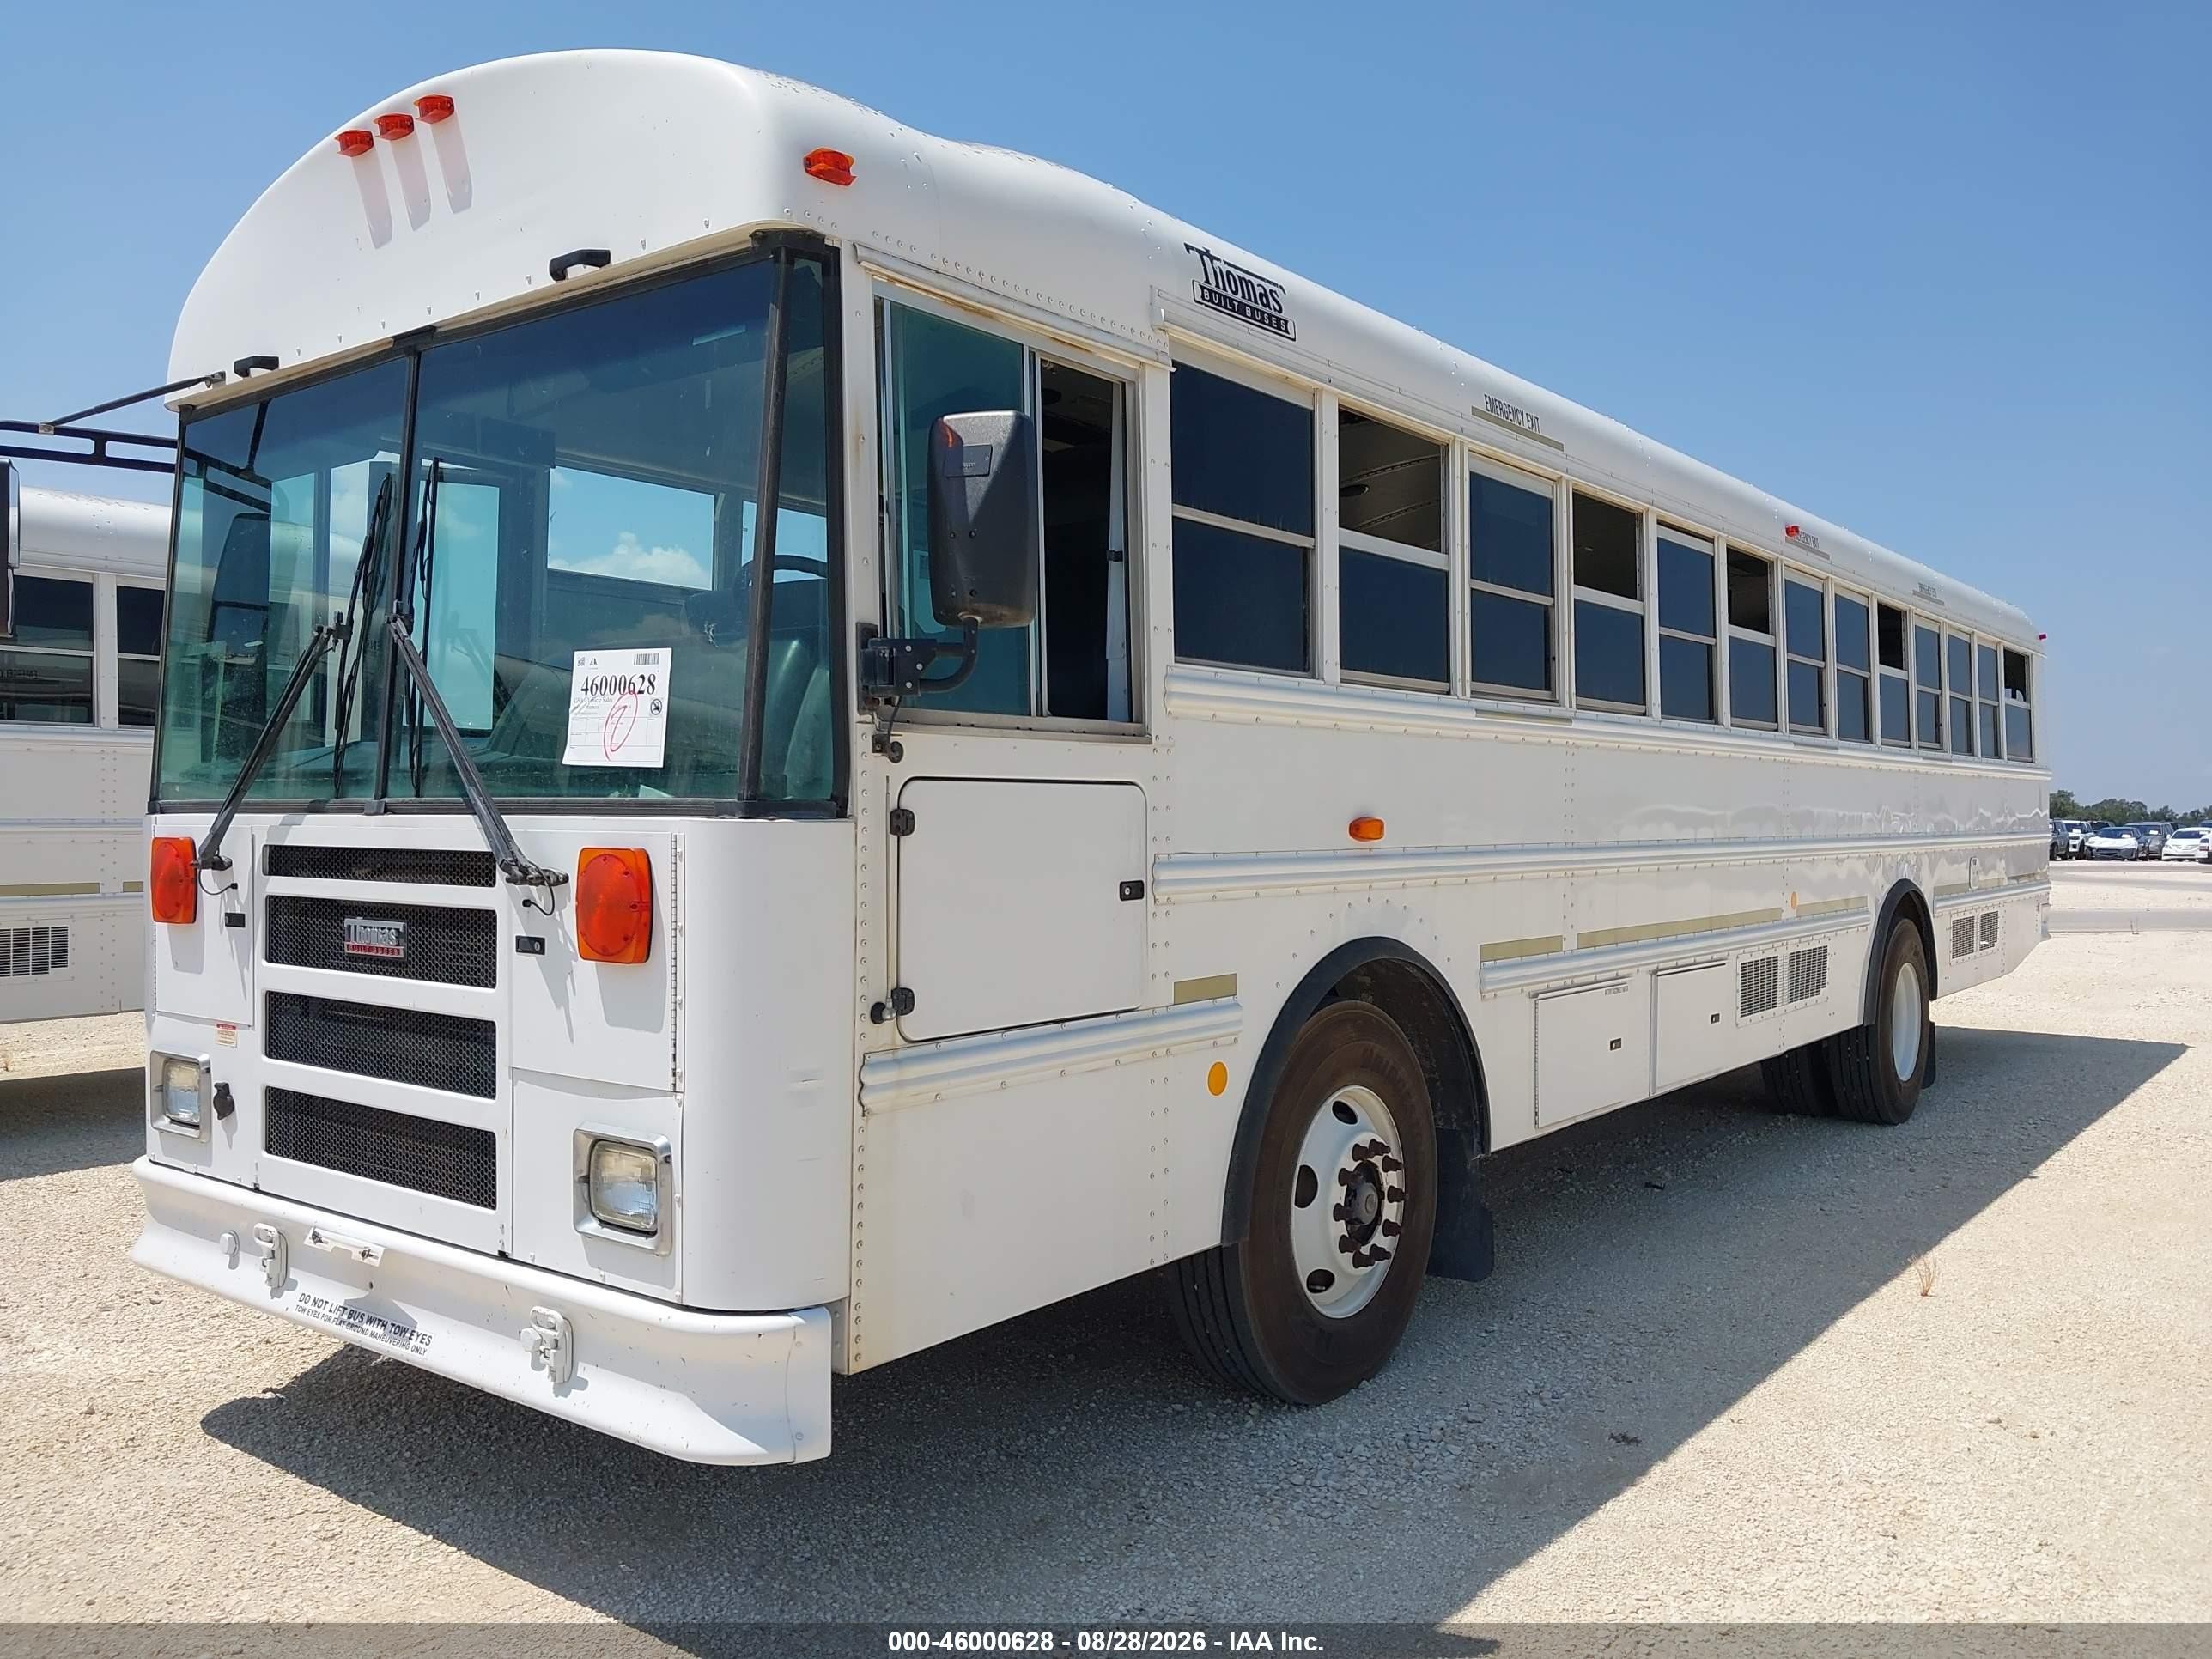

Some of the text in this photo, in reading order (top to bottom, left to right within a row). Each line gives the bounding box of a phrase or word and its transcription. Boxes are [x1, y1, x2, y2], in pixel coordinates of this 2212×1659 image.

[1184, 241, 1286, 314] Thomas
[1203, 289, 1286, 331] BUILT BUSES
[1484, 394, 1540, 434] EMERGENCY EXIT
[580, 673, 657, 696] 46000628
[295, 1304, 428, 1356] TOW EYES FOR FLAT GROUND MANEUVERING ONLY
[298, 1292, 433, 1346] DO NOT LIFT BUS WITH TOW EYES
